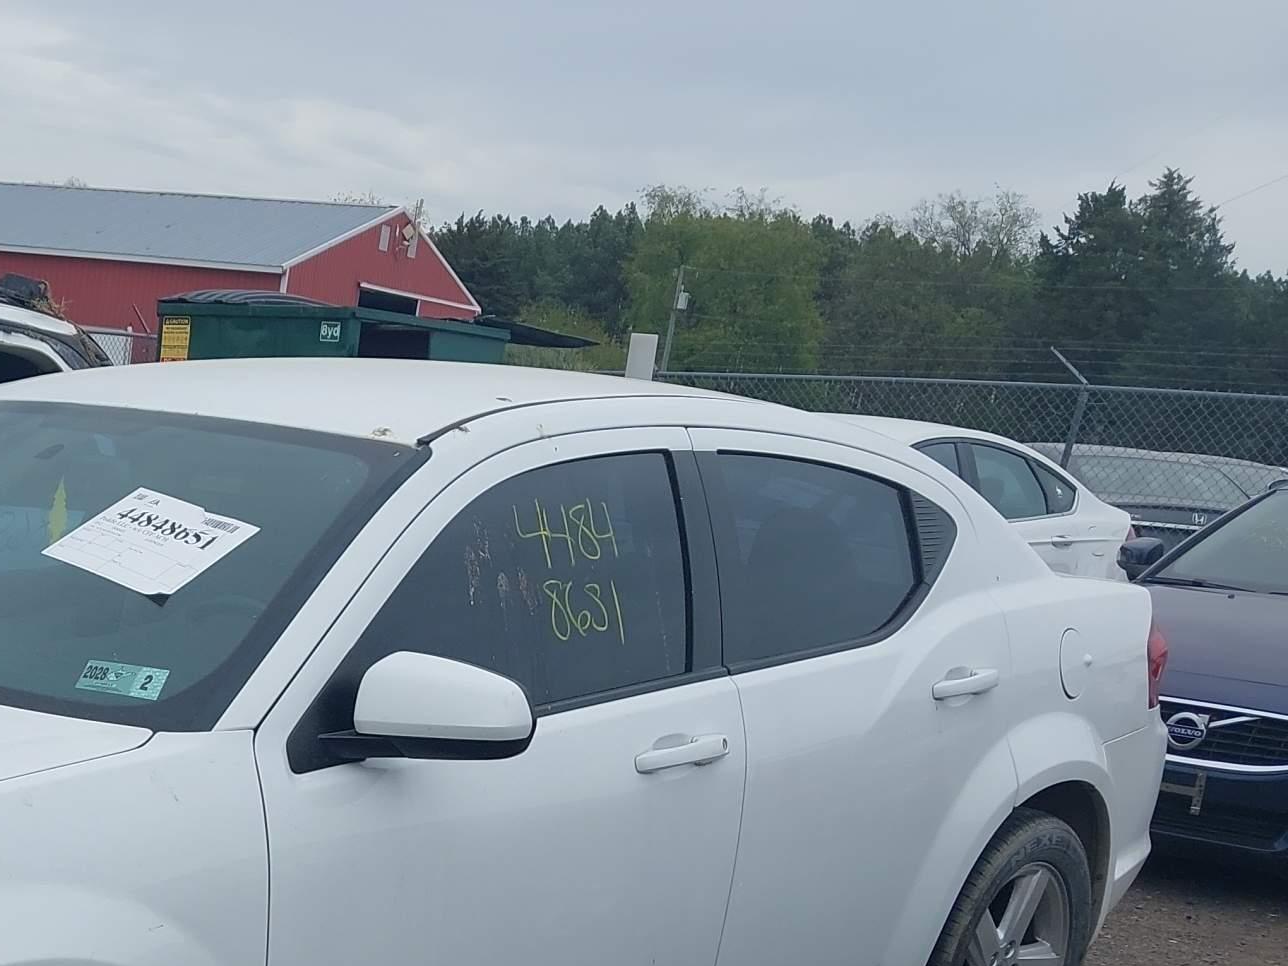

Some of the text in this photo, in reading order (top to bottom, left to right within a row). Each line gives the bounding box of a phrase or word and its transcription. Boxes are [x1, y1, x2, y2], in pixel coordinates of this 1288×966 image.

[116, 507, 219, 551] 44848651
[513, 498, 619, 569] 4484
[82, 664, 110, 681] 2028
[138, 674, 154, 691] 2
[1168, 726, 1202, 738] VOLVO
